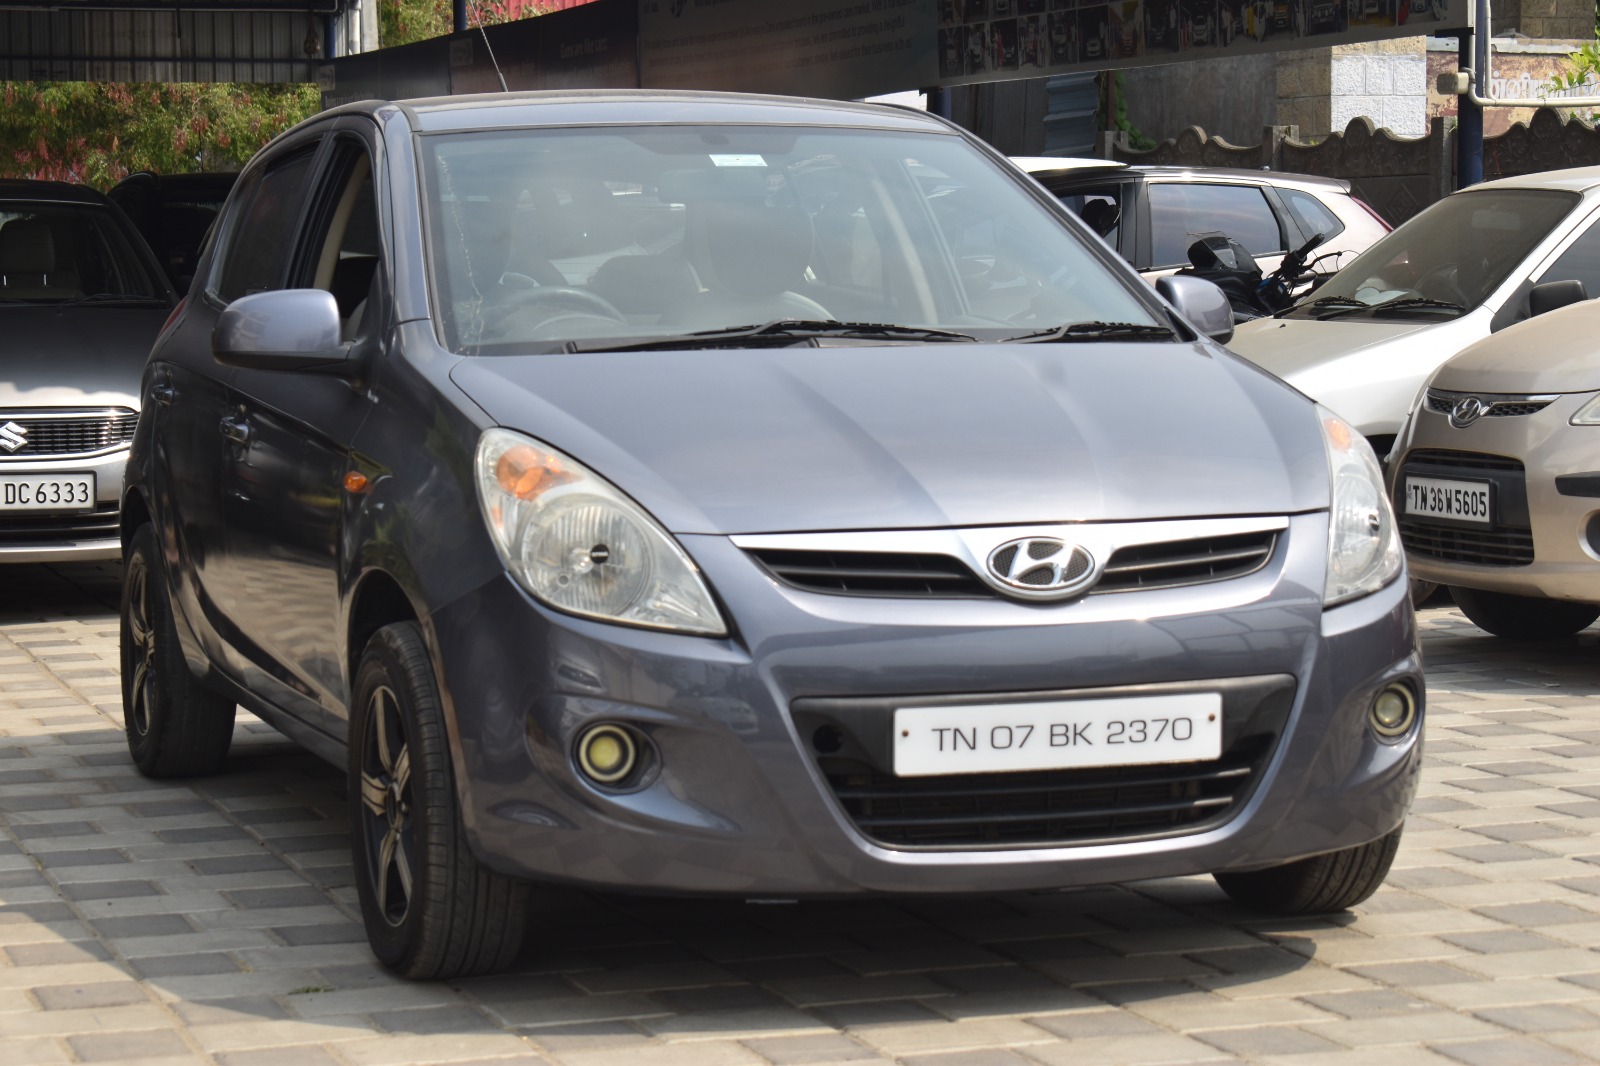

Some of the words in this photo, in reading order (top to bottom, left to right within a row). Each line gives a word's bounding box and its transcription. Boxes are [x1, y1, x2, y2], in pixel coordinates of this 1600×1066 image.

[5, 483, 30, 504] DC
[36, 483, 89, 503] 6333
[932, 727, 977, 751] TN
[991, 725, 1035, 749] 07
[1050, 723, 1093, 746] BK
[1107, 718, 1193, 744] 2370
